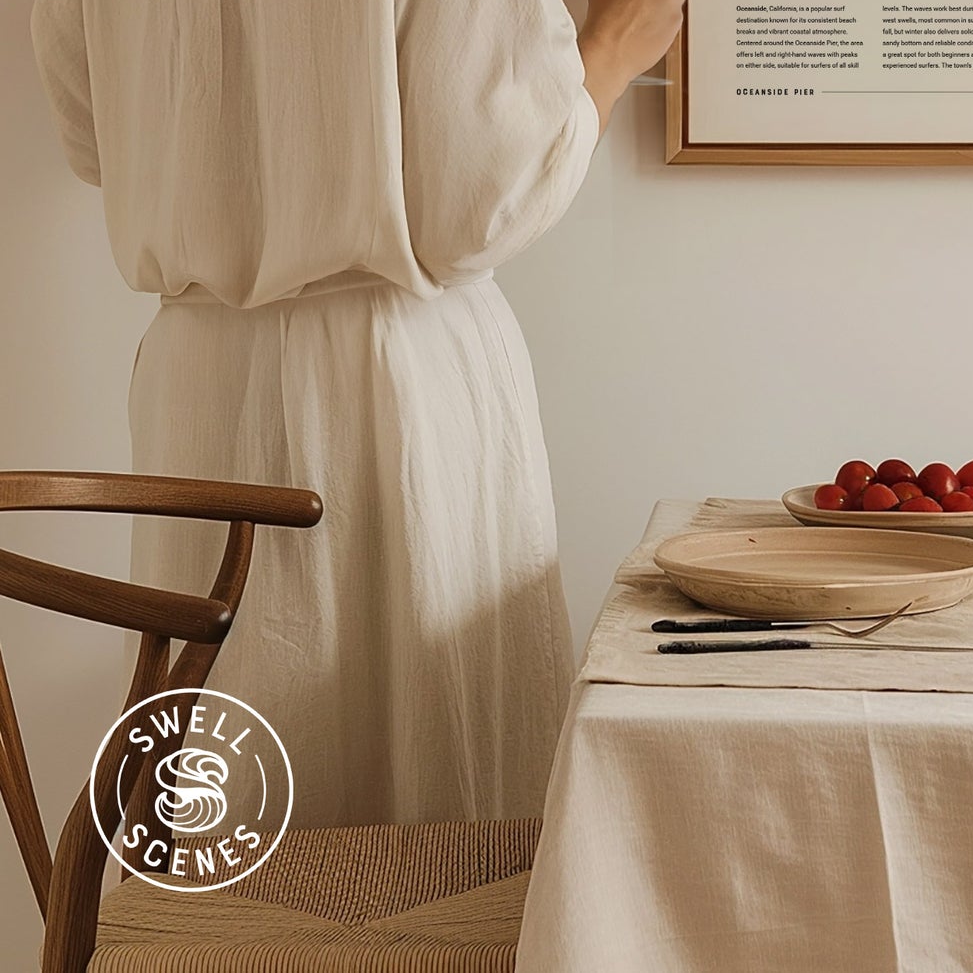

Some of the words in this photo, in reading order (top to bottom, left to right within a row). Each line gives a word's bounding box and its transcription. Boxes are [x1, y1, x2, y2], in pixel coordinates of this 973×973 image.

[735, 5, 769, 13] Oceanside,
[768, 5, 798, 13] California,
[810, 5, 833, 13] popular
[812, 28, 848, 36] atmosphere.
[882, 40, 900, 48] sandy
[777, 51, 807, 59] right-hand
[840, 51, 858, 59] peaks
[941, 51, 970, 59] beginners
[882, 62, 918, 70] experienced
[736, 88, 789, 96] OCEANSIDE
[794, 88, 814, 96] PIER
